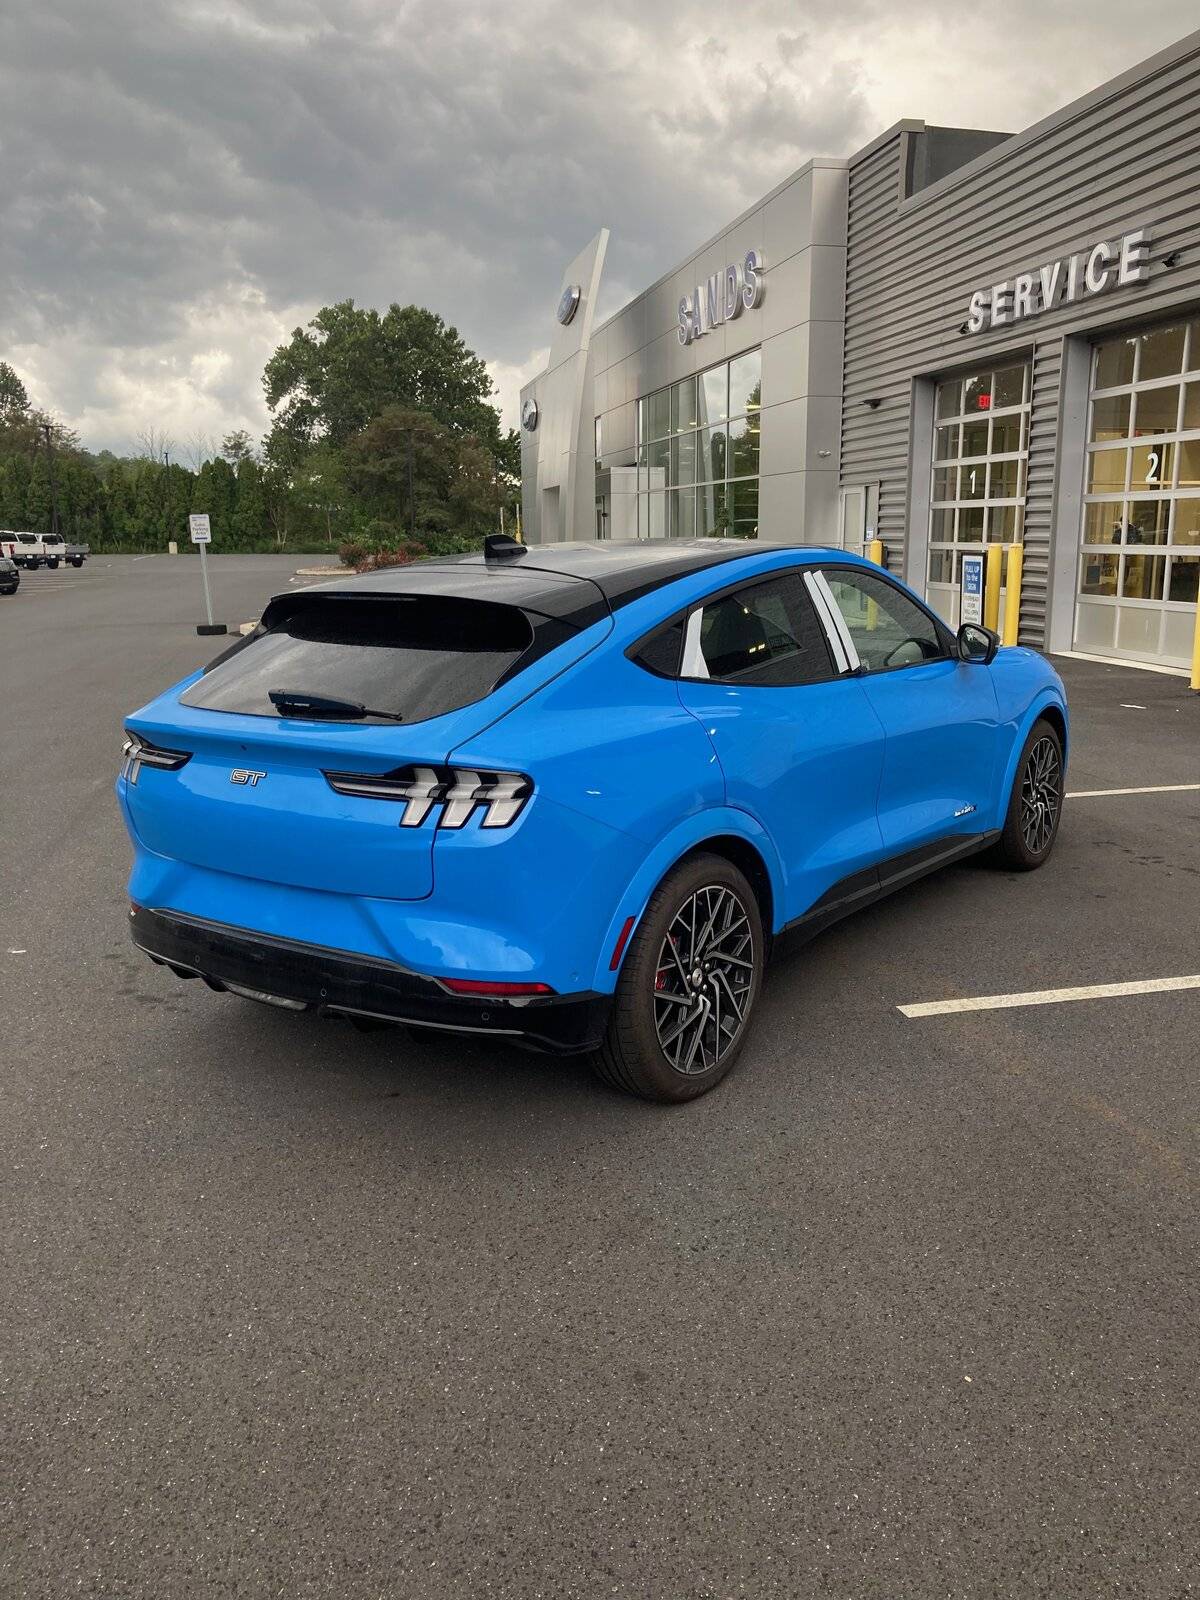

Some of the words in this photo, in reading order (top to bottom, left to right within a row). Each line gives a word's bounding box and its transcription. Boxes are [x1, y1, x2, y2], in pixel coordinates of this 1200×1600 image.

[968, 230, 1149, 333] SERVICE
[677, 249, 763, 345] SANDS
[1146, 452, 1158, 482] 2
[970, 470, 975, 494] 1
[973, 565, 980, 573] UP
[230, 768, 267, 787] GT
